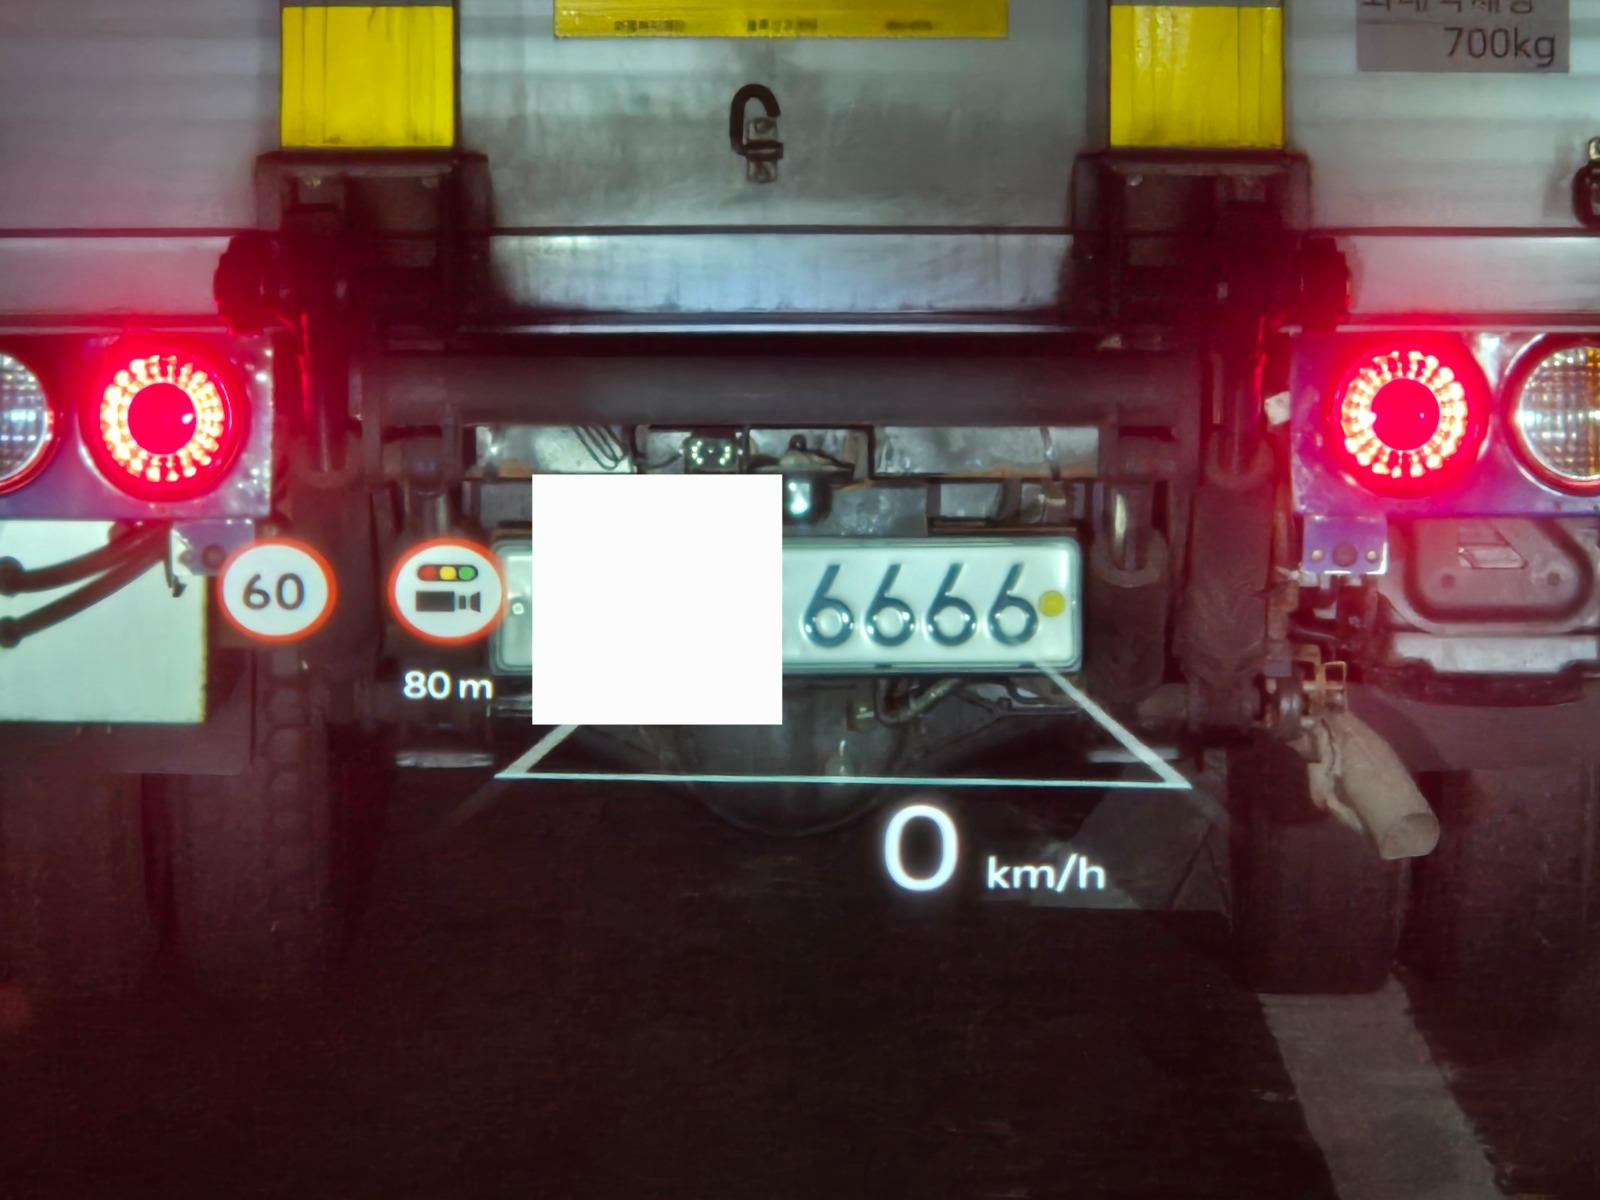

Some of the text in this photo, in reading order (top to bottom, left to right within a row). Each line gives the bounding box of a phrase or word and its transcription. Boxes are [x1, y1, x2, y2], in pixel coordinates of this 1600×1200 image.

[1443, 27, 1556, 67] 700kg
[242, 573, 304, 610] 60
[804, 563, 1039, 648] 6666
[404, 671, 493, 699] 80 m
[884, 804, 1106, 892] 0 km/h
